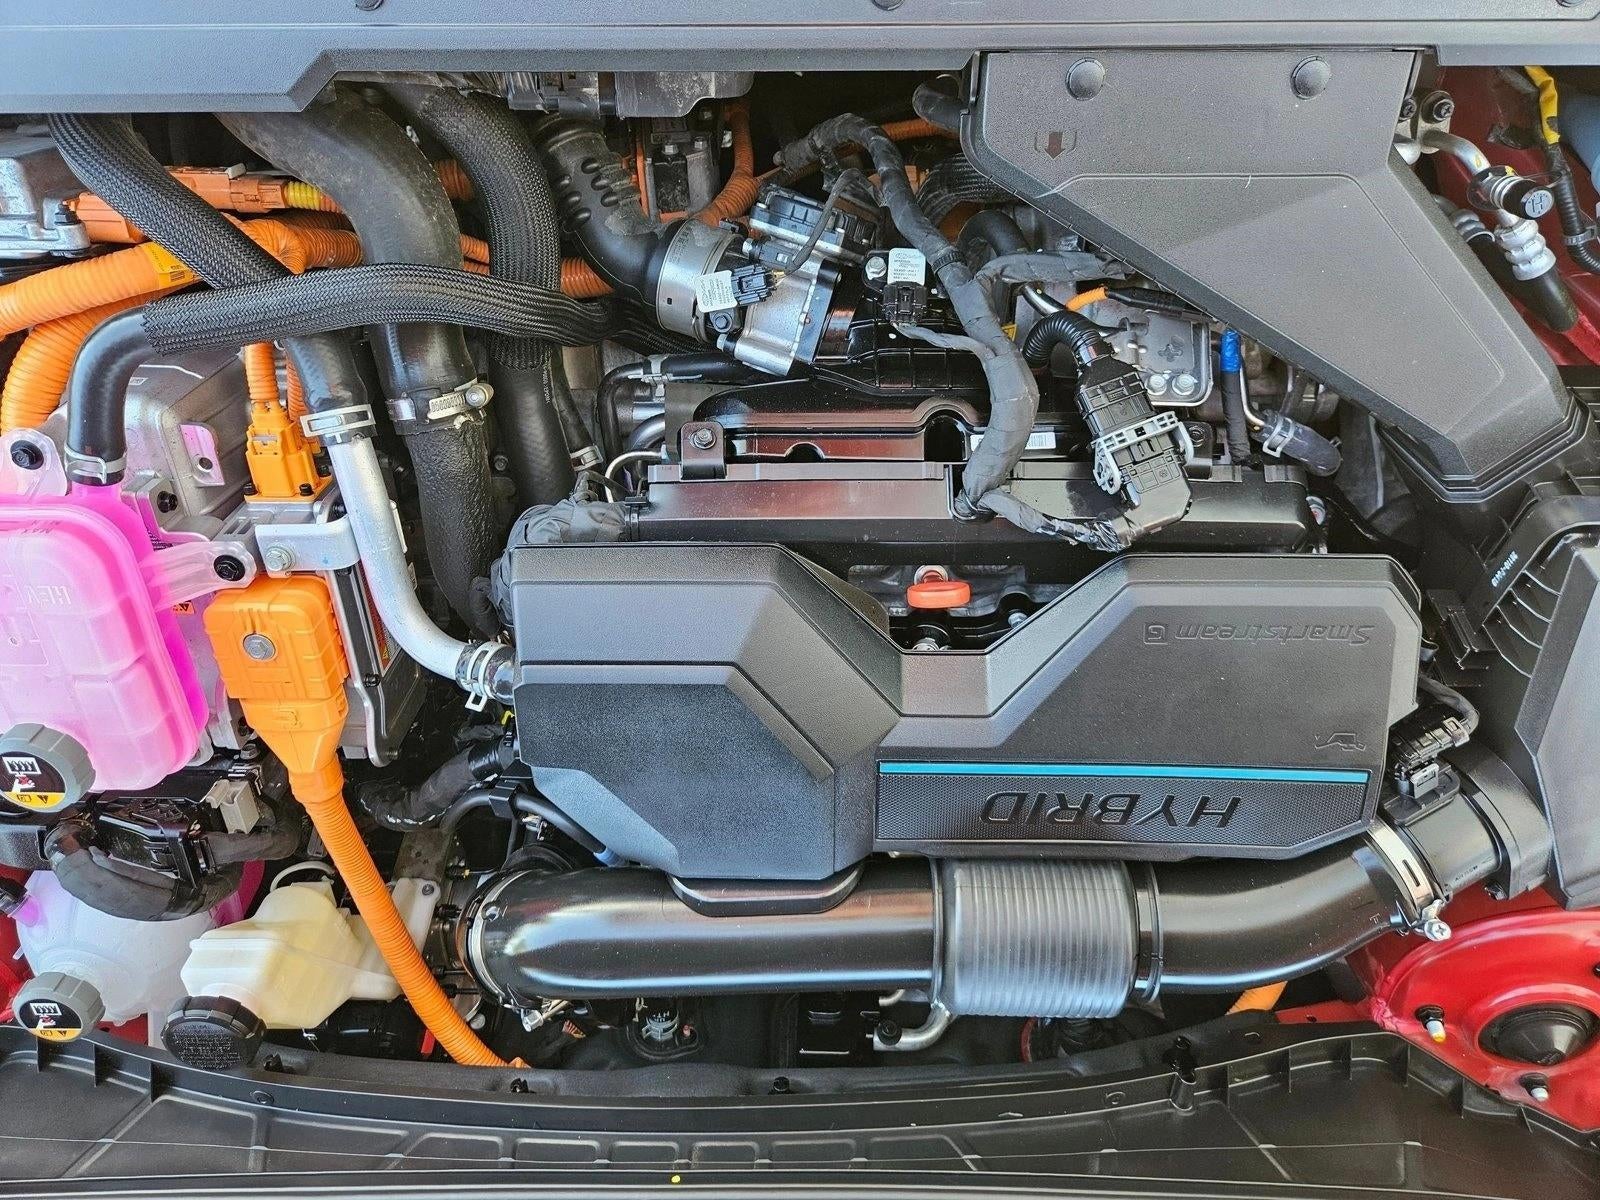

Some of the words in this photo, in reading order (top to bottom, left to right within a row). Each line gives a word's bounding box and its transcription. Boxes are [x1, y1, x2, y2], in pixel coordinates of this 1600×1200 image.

[1146, 625, 1167, 643] G
[1174, 624, 1375, 646] Smartstream
[979, 790, 1241, 828] HYBRID
